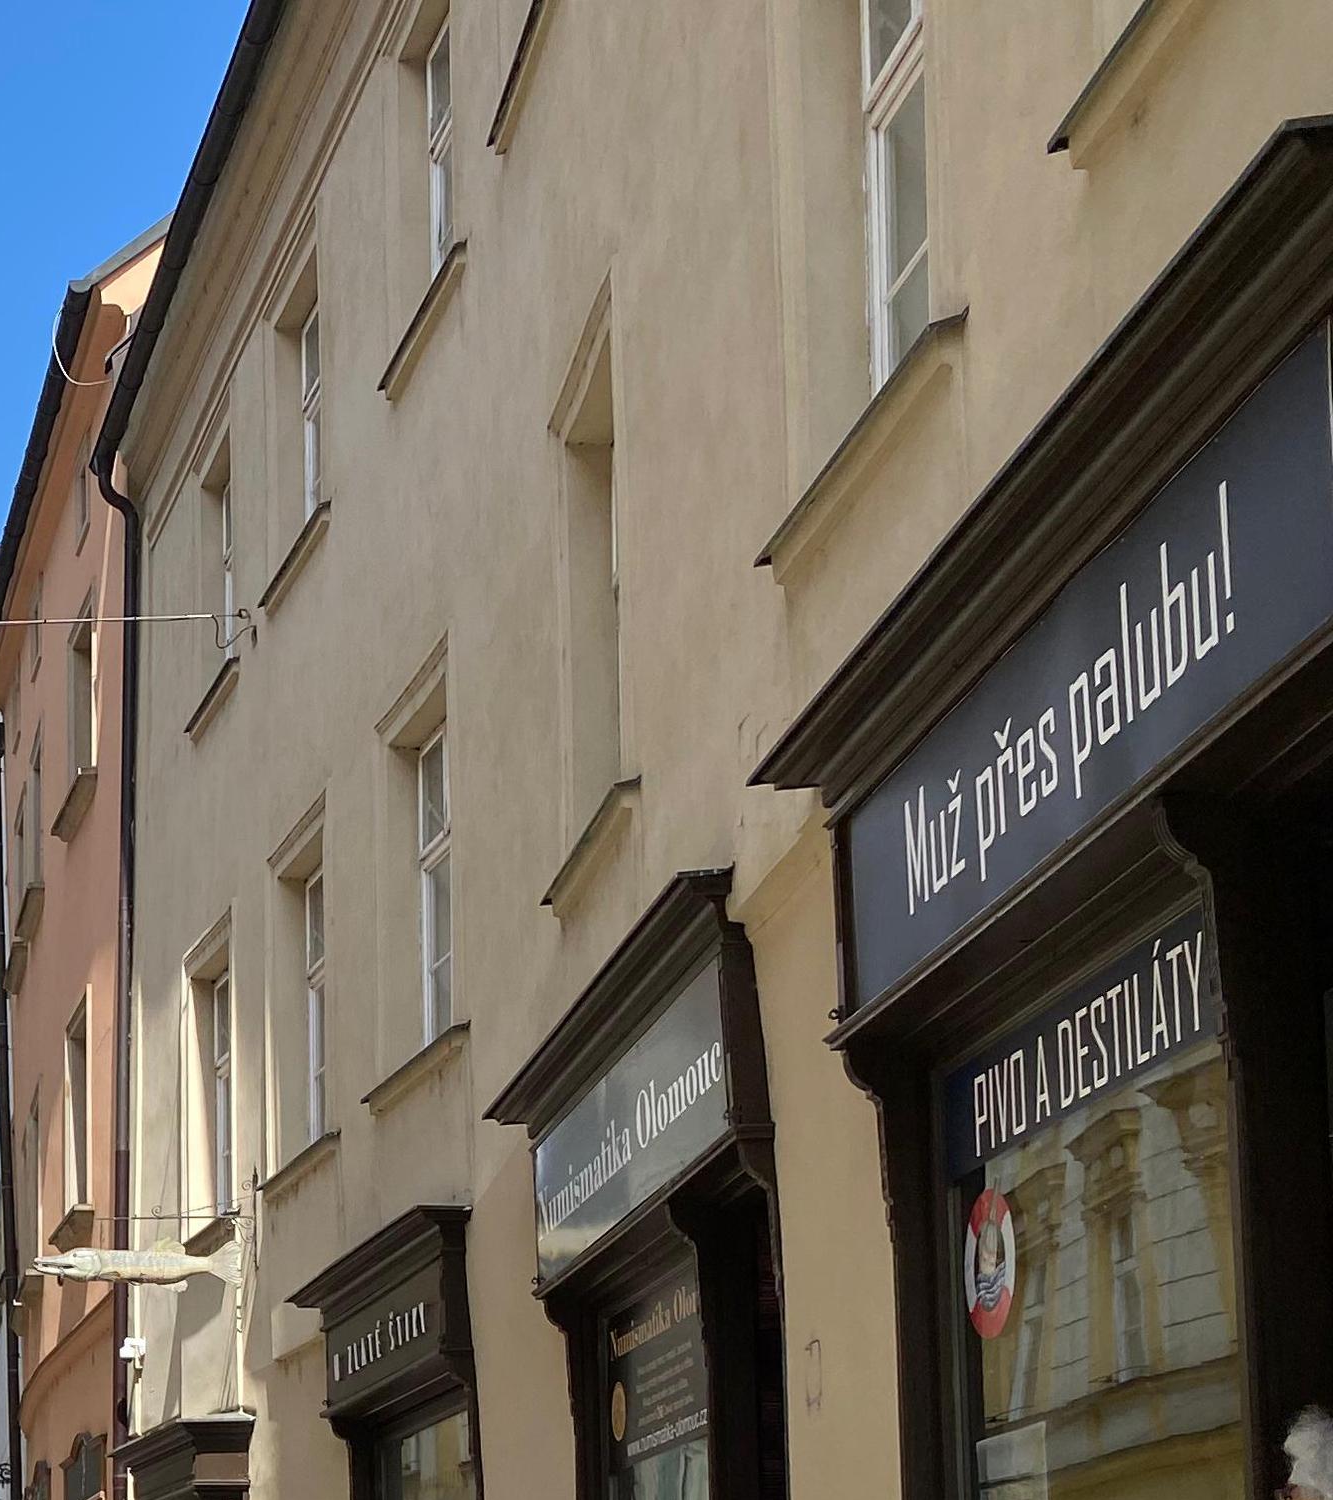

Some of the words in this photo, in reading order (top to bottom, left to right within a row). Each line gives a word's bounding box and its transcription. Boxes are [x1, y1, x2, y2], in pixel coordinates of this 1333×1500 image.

[903, 768, 967, 916] Muž
[975, 716, 1057, 883] přes
[1068, 479, 1236, 800] palubu!
[536, 1120, 633, 1241] Numismatika
[635, 1040, 723, 1149] Olomouc
[973, 1048, 1028, 1158] PIVO
[1035, 1034, 1052, 1124] A
[1056, 930, 1205, 1109] DESTILÁTY
[610, 1301, 671, 1362] Numismatika
